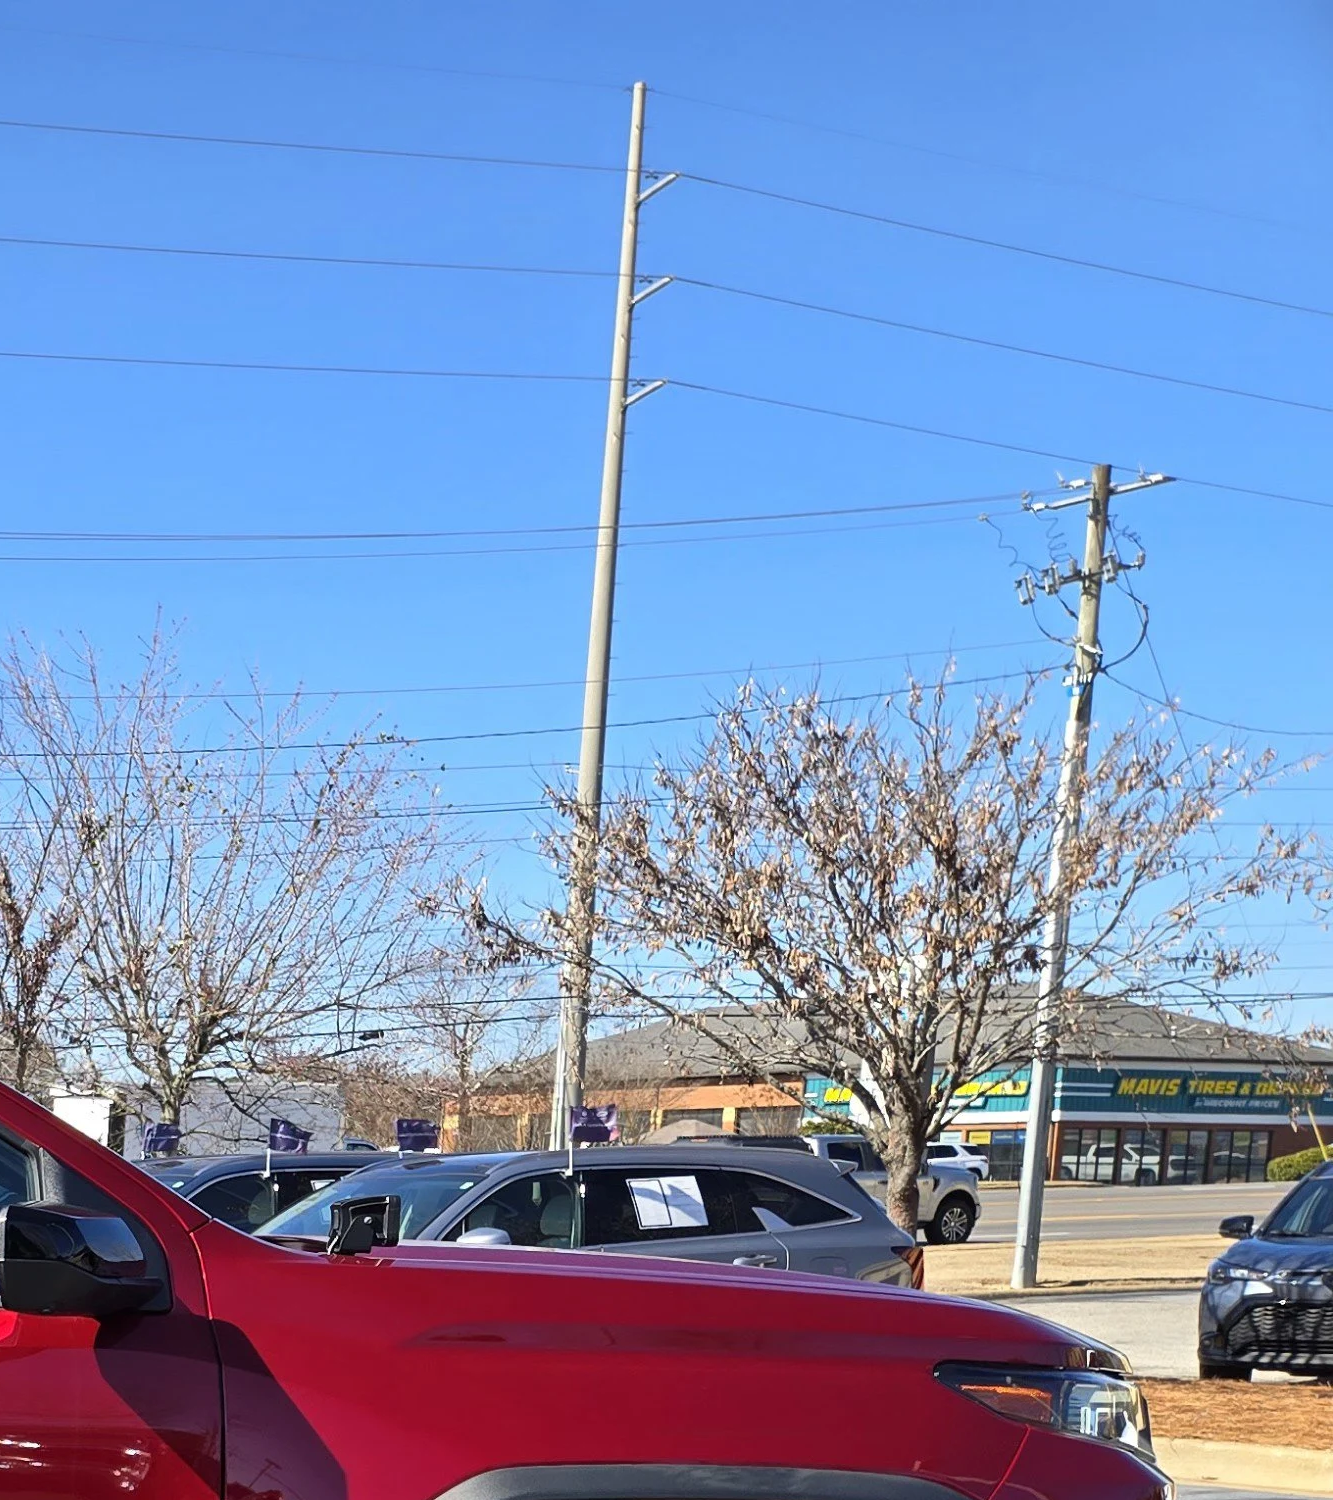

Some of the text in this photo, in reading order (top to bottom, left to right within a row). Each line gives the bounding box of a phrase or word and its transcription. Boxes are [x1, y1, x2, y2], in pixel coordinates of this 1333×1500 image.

[1118, 1078, 1181, 1096] MAVIS
[1188, 1079, 1235, 1096] TIRES
[1239, 1081, 1251, 1096] &
